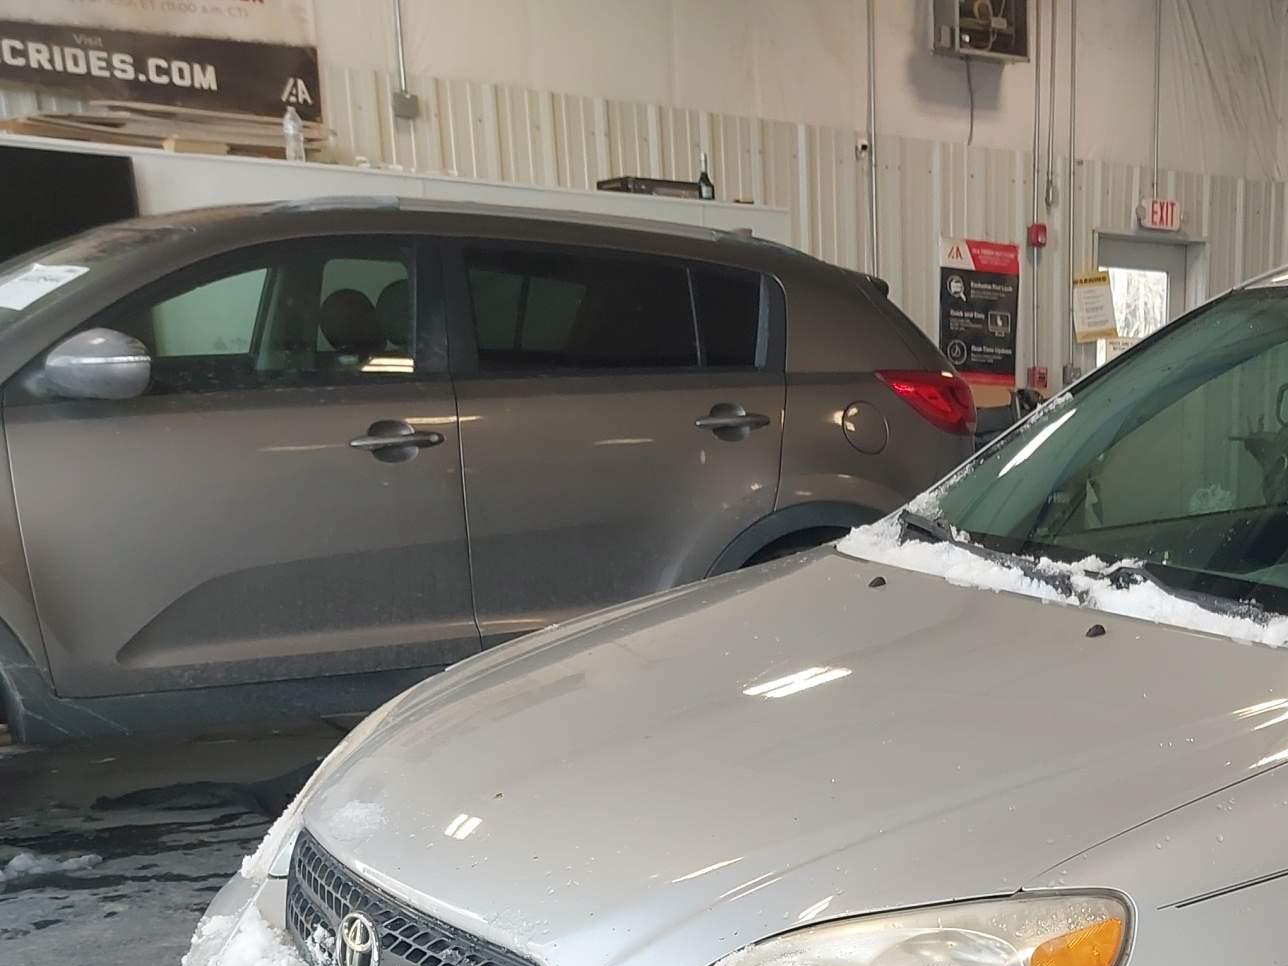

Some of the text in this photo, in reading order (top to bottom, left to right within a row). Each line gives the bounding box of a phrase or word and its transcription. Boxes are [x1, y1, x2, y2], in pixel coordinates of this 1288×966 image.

[72, 33, 103, 48] Visit
[0, 38, 218, 91] CRIDES.COM
[1151, 200, 1176, 227] EXIT
